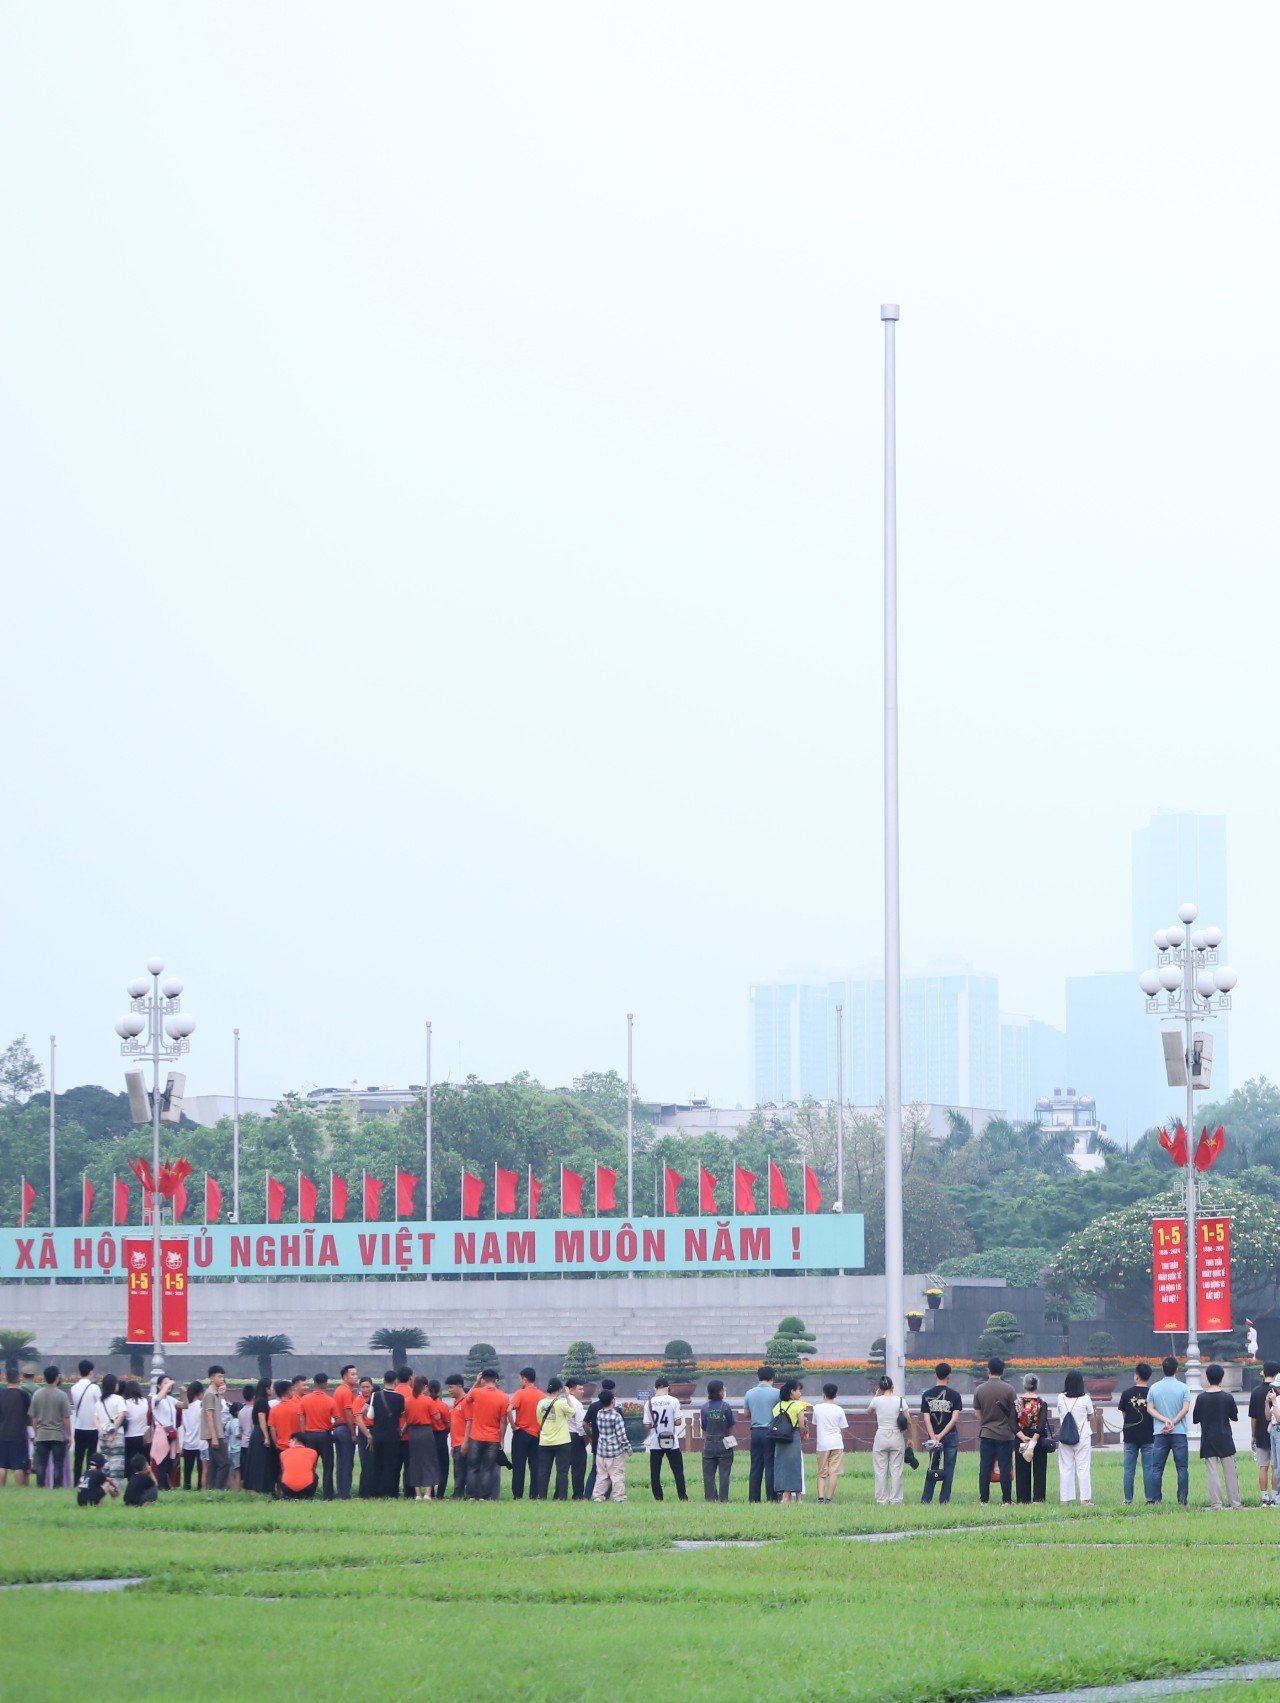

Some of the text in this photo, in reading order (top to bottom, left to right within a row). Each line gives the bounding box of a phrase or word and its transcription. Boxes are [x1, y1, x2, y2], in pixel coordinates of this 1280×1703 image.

[1158, 1226, 1181, 1246] 1-5
[1202, 1224, 1225, 1243] 1-5
[15, 1232, 58, 1270] XÃ
[230, 1228, 339, 1268] NGHĨA
[358, 1226, 436, 1271] VIỆT
[454, 1231, 536, 1265] NAM
[554, 1222, 666, 1263] MUÔN
[684, 1220, 771, 1262] NĂM
[130, 1272, 148, 1289] 1-5
[164, 1273, 184, 1290] 1-5
